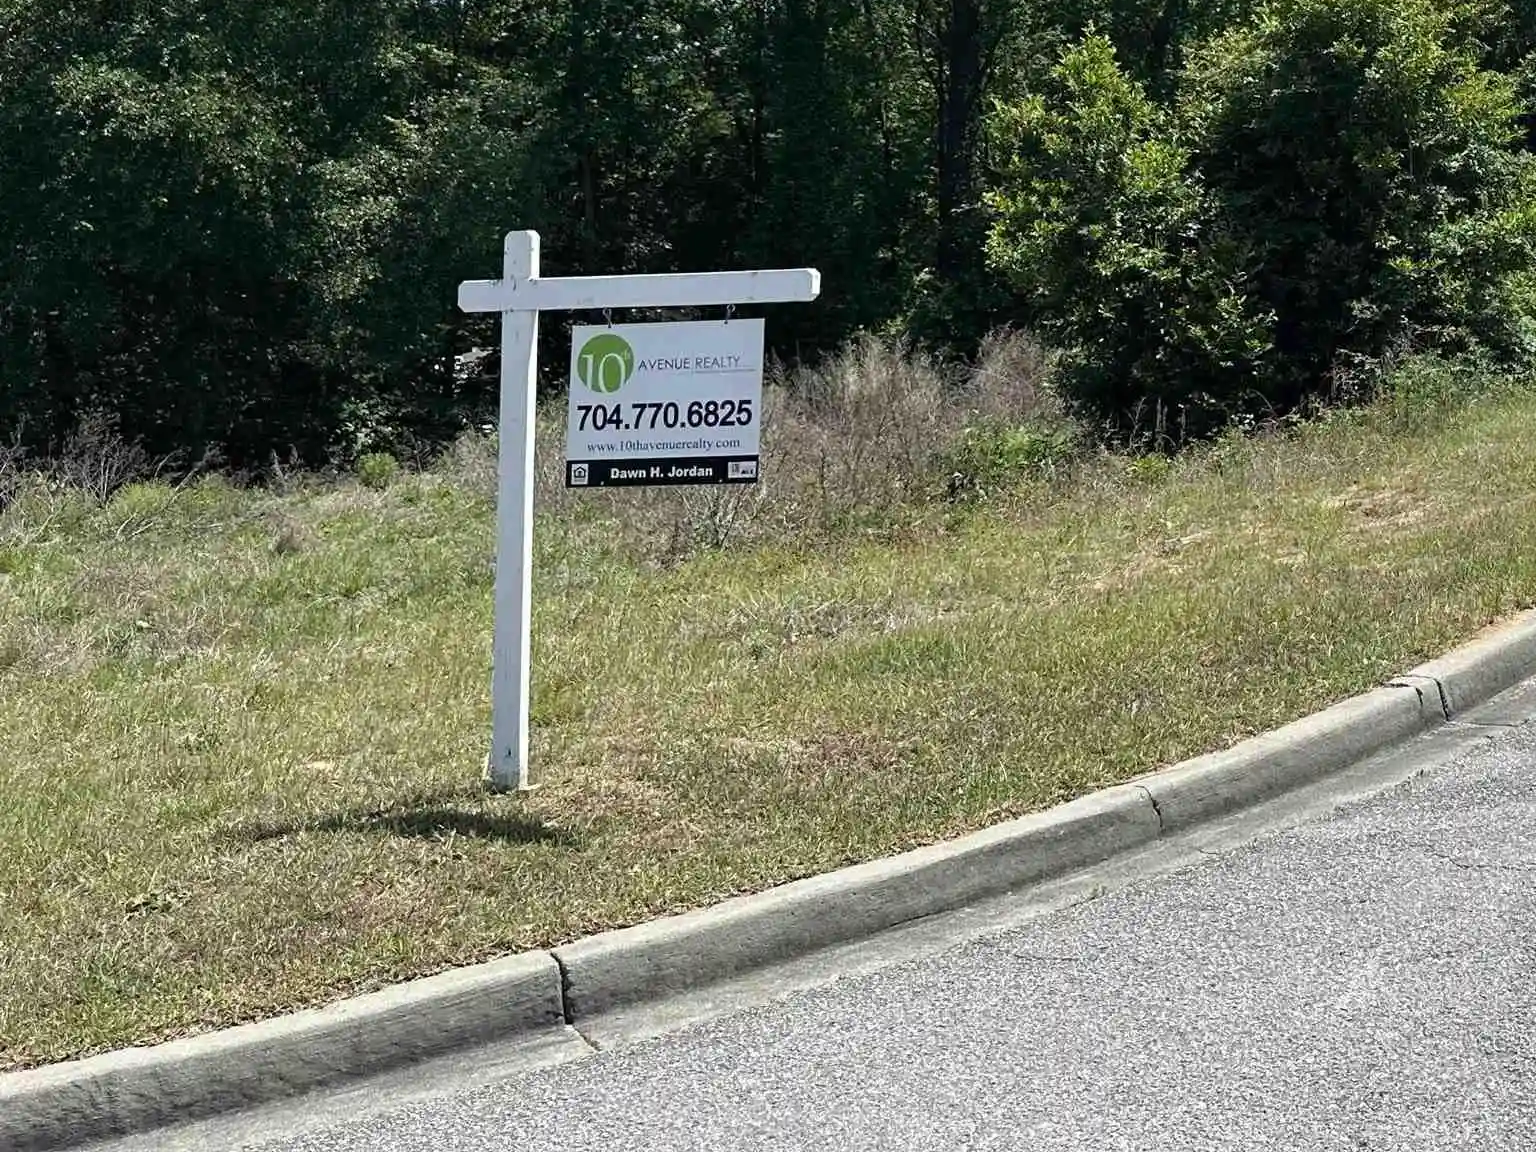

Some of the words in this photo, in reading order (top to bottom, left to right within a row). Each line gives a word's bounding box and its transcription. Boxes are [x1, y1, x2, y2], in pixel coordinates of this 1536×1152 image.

[638, 358, 690, 371] AVENUE
[695, 355, 741, 369] REALTY
[577, 399, 753, 432] 704.770.6825
[587, 437, 741, 453] www.10thavenuerealty.com
[610, 466, 647, 480] Dawn
[650, 466, 664, 478] H.
[667, 464, 713, 478] Jordan
